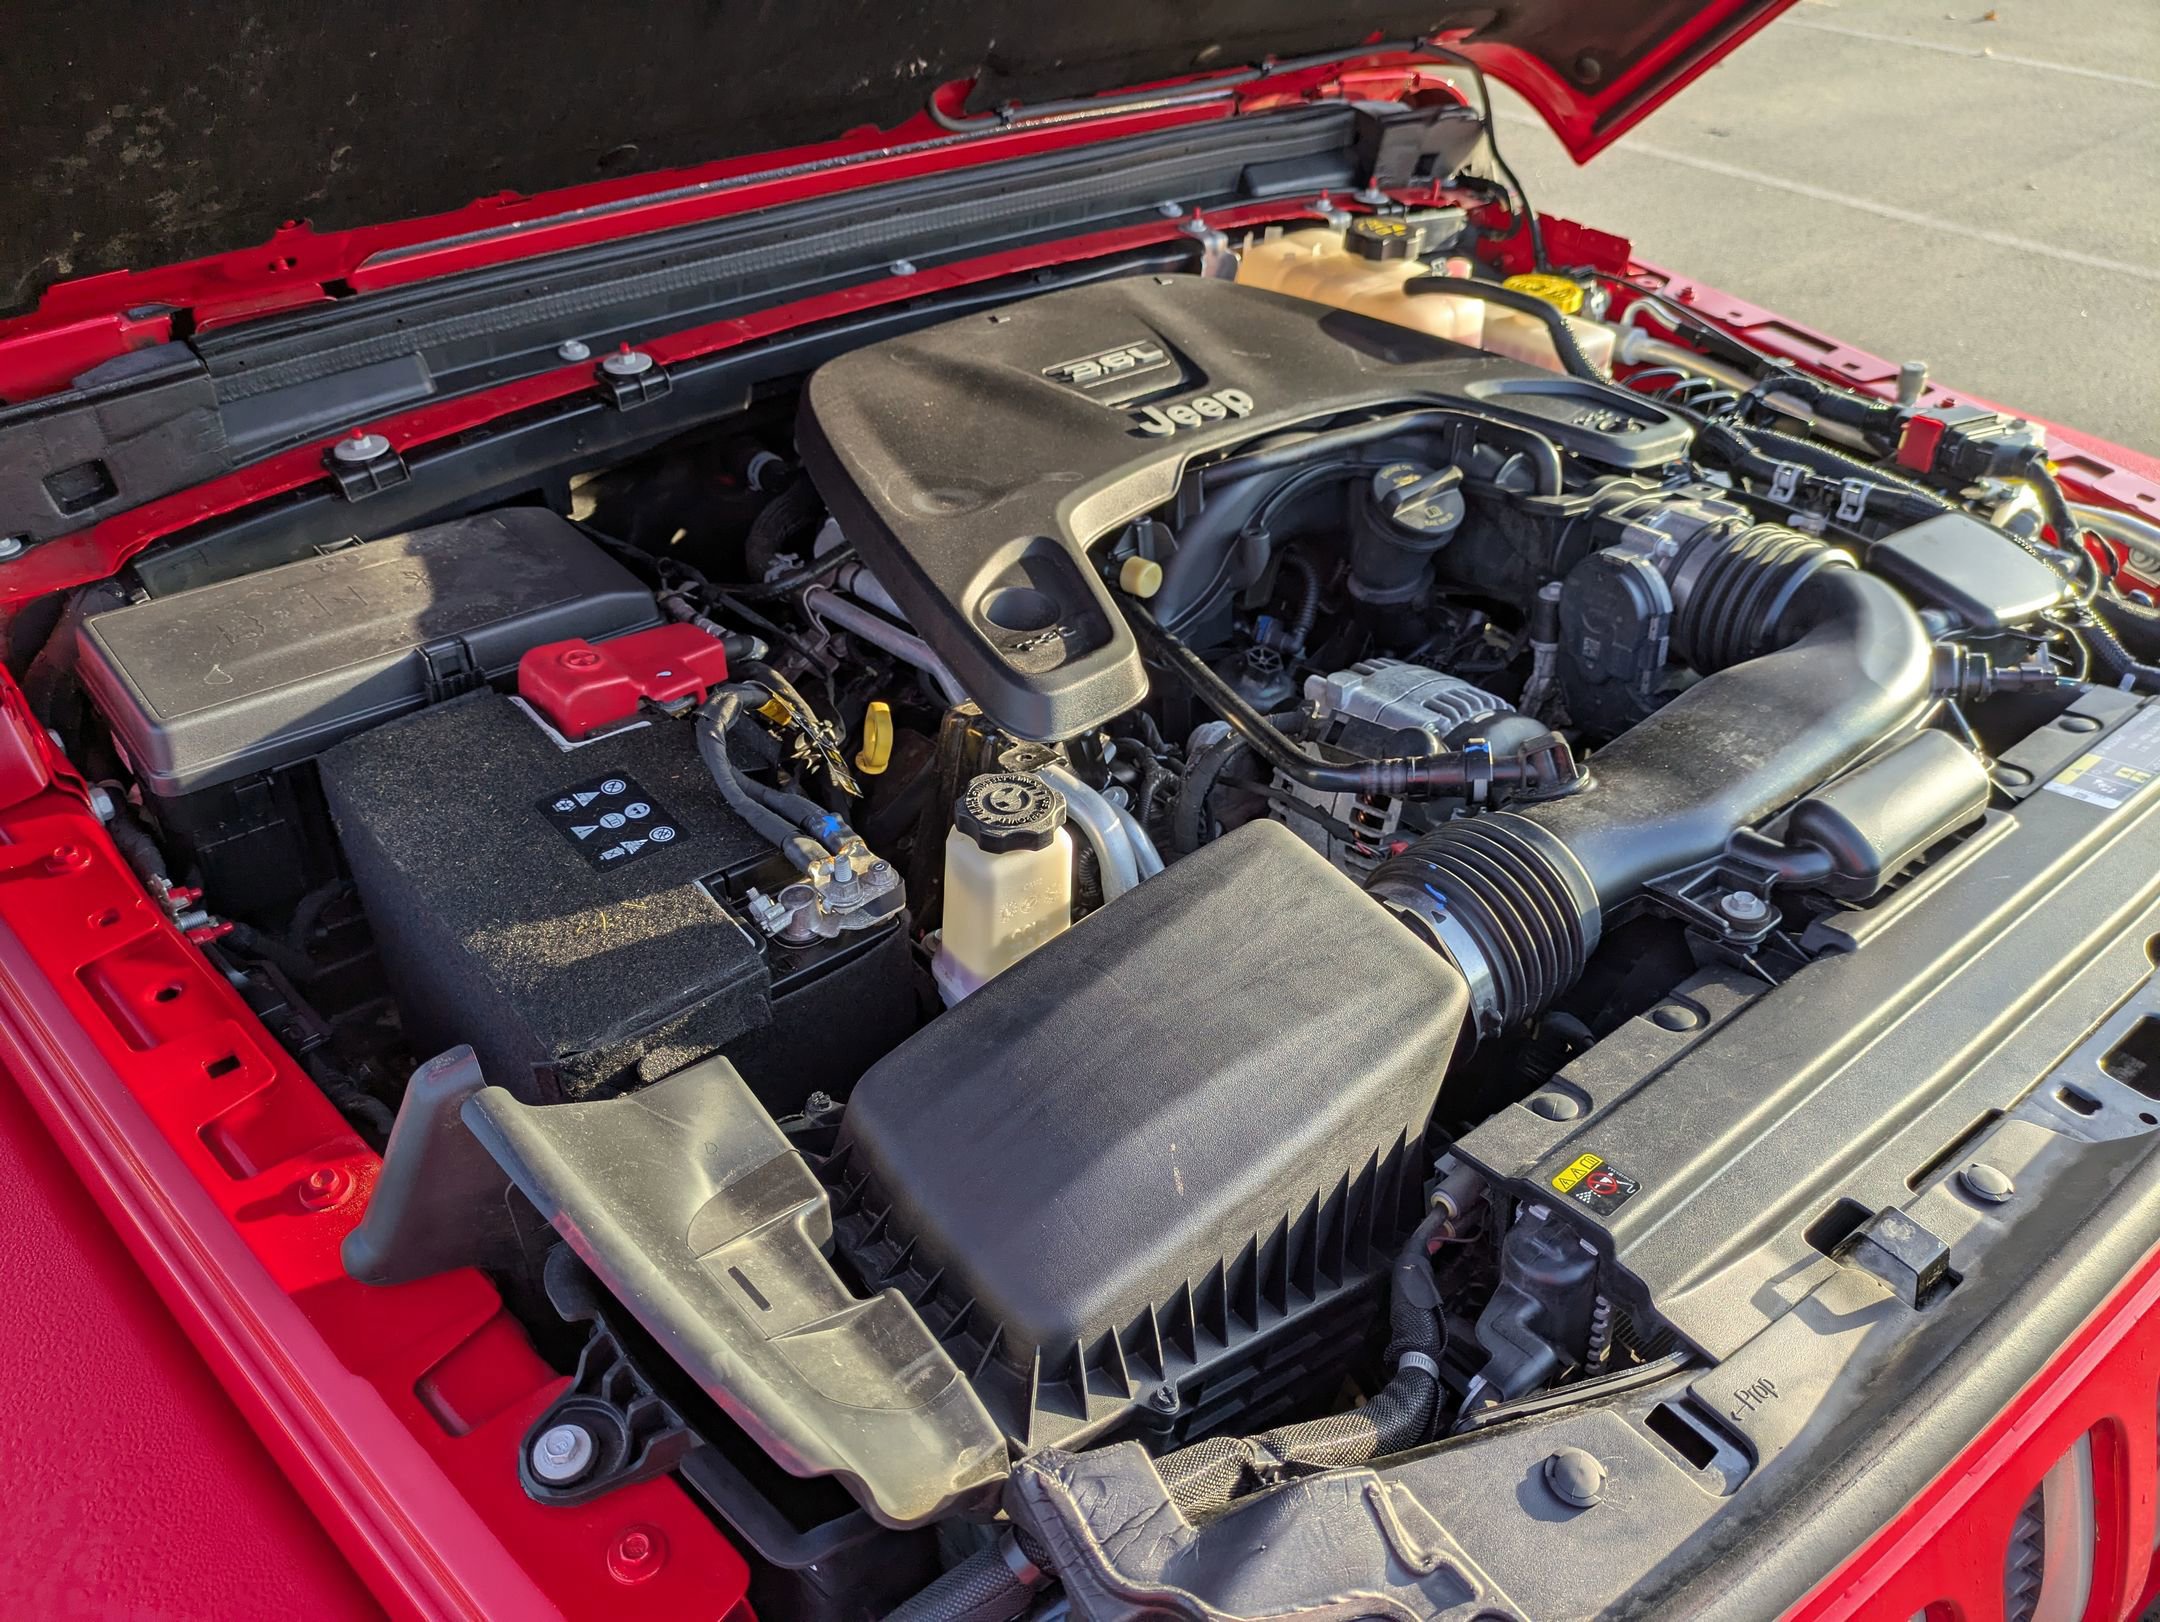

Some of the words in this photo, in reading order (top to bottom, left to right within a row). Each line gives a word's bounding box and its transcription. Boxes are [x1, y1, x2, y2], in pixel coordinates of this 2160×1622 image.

[1063, 346, 1164, 383] 3.6L
[1138, 387, 1254, 437] Jeep
[1733, 1376, 1779, 1412] Prop
